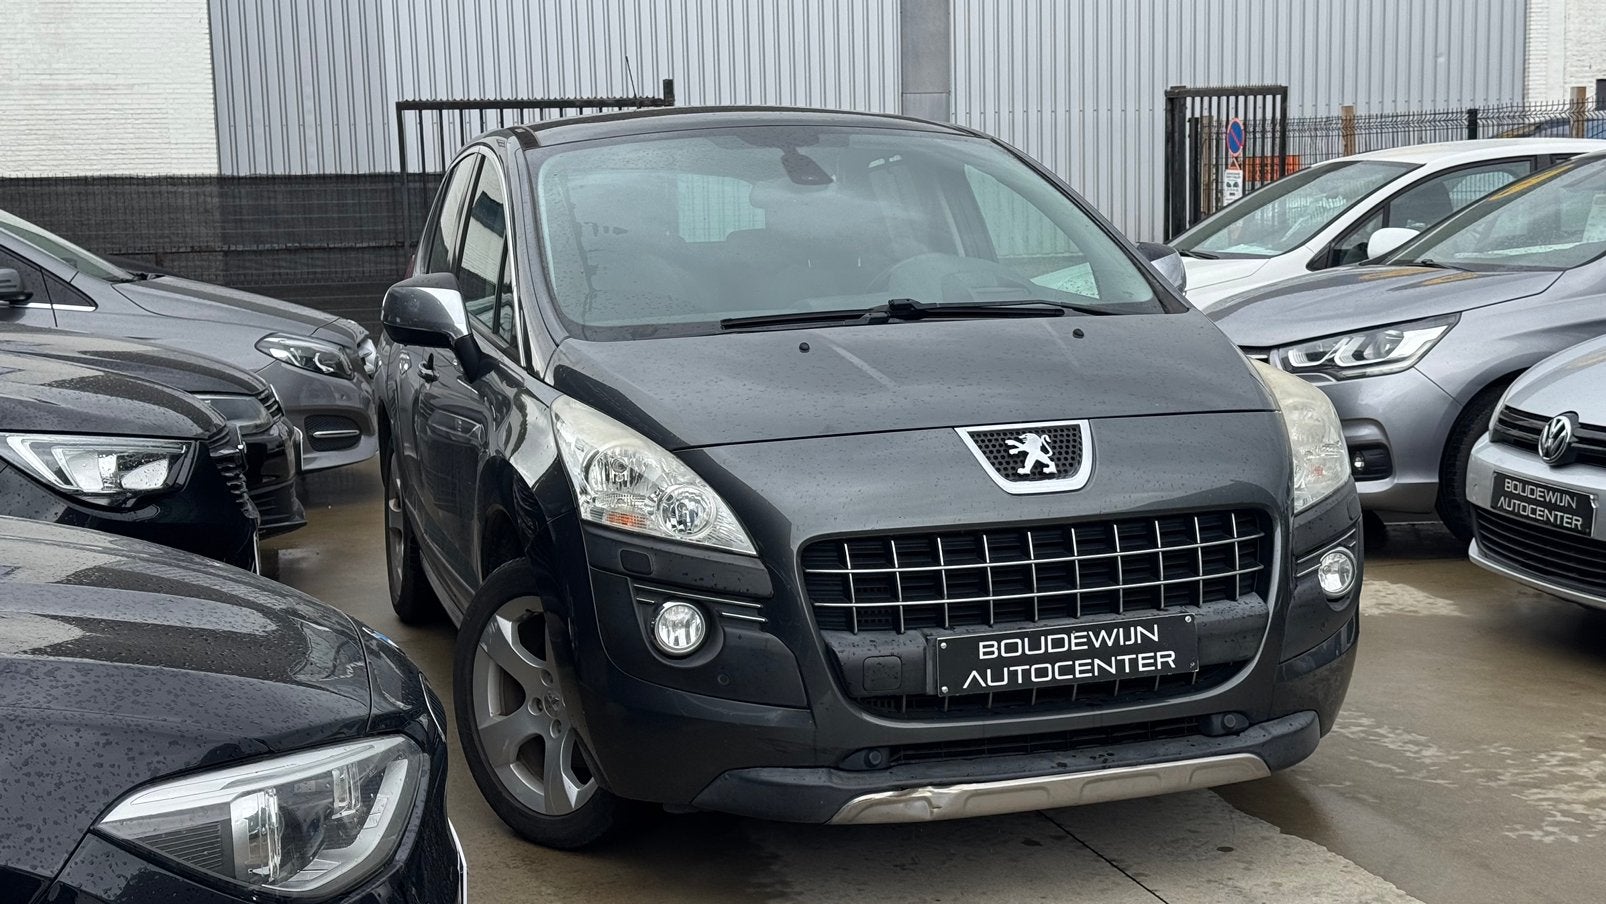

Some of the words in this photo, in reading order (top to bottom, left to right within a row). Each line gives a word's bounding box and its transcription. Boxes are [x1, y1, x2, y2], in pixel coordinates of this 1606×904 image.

[1504, 479, 1577, 509] BOUDEWIJN
[1498, 496, 1582, 530] AUTOCENTER
[979, 624, 1159, 660] BOUDEWIJN
[963, 650, 1176, 689] AUTOCENTER
